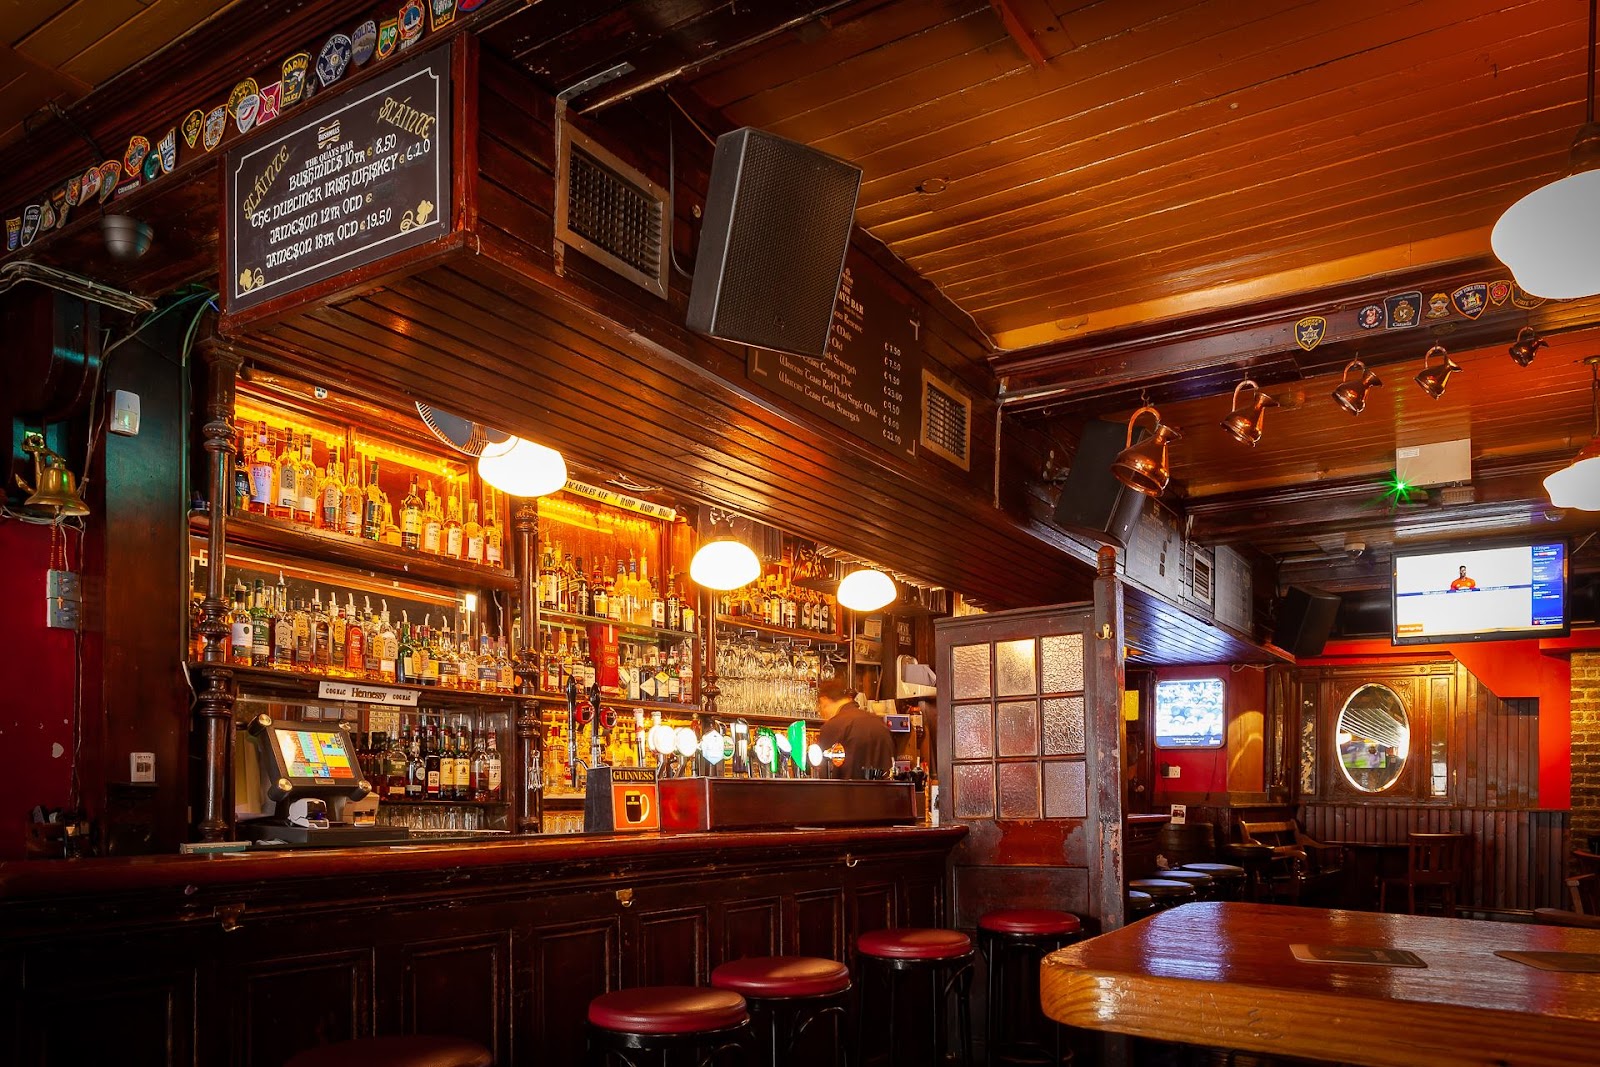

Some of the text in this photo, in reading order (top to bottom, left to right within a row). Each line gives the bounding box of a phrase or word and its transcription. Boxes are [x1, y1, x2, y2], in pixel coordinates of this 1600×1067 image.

[283, 58, 309, 77] PARMA
[377, 97, 436, 139] SLÁINTE
[375, 133, 397, 154] 8.50
[305, 140, 354, 169] THE QUAYS BAR
[243, 145, 290, 220] SLÁINTE
[250, 207, 271, 229] THE
[269, 212, 318, 244] JAMESON
[342, 194, 363, 214] OLD
[266, 238, 313, 268] JAMESON
[337, 220, 358, 241] OLD
[1454, 290, 1464, 299] NEW
[850, 298, 864, 315] BAR
[620, 497, 636, 508] HARP
[325, 688, 346, 696] COGNAC
[351, 687, 387, 702] Hennessy
[613, 770, 655, 780] GUINNESS
